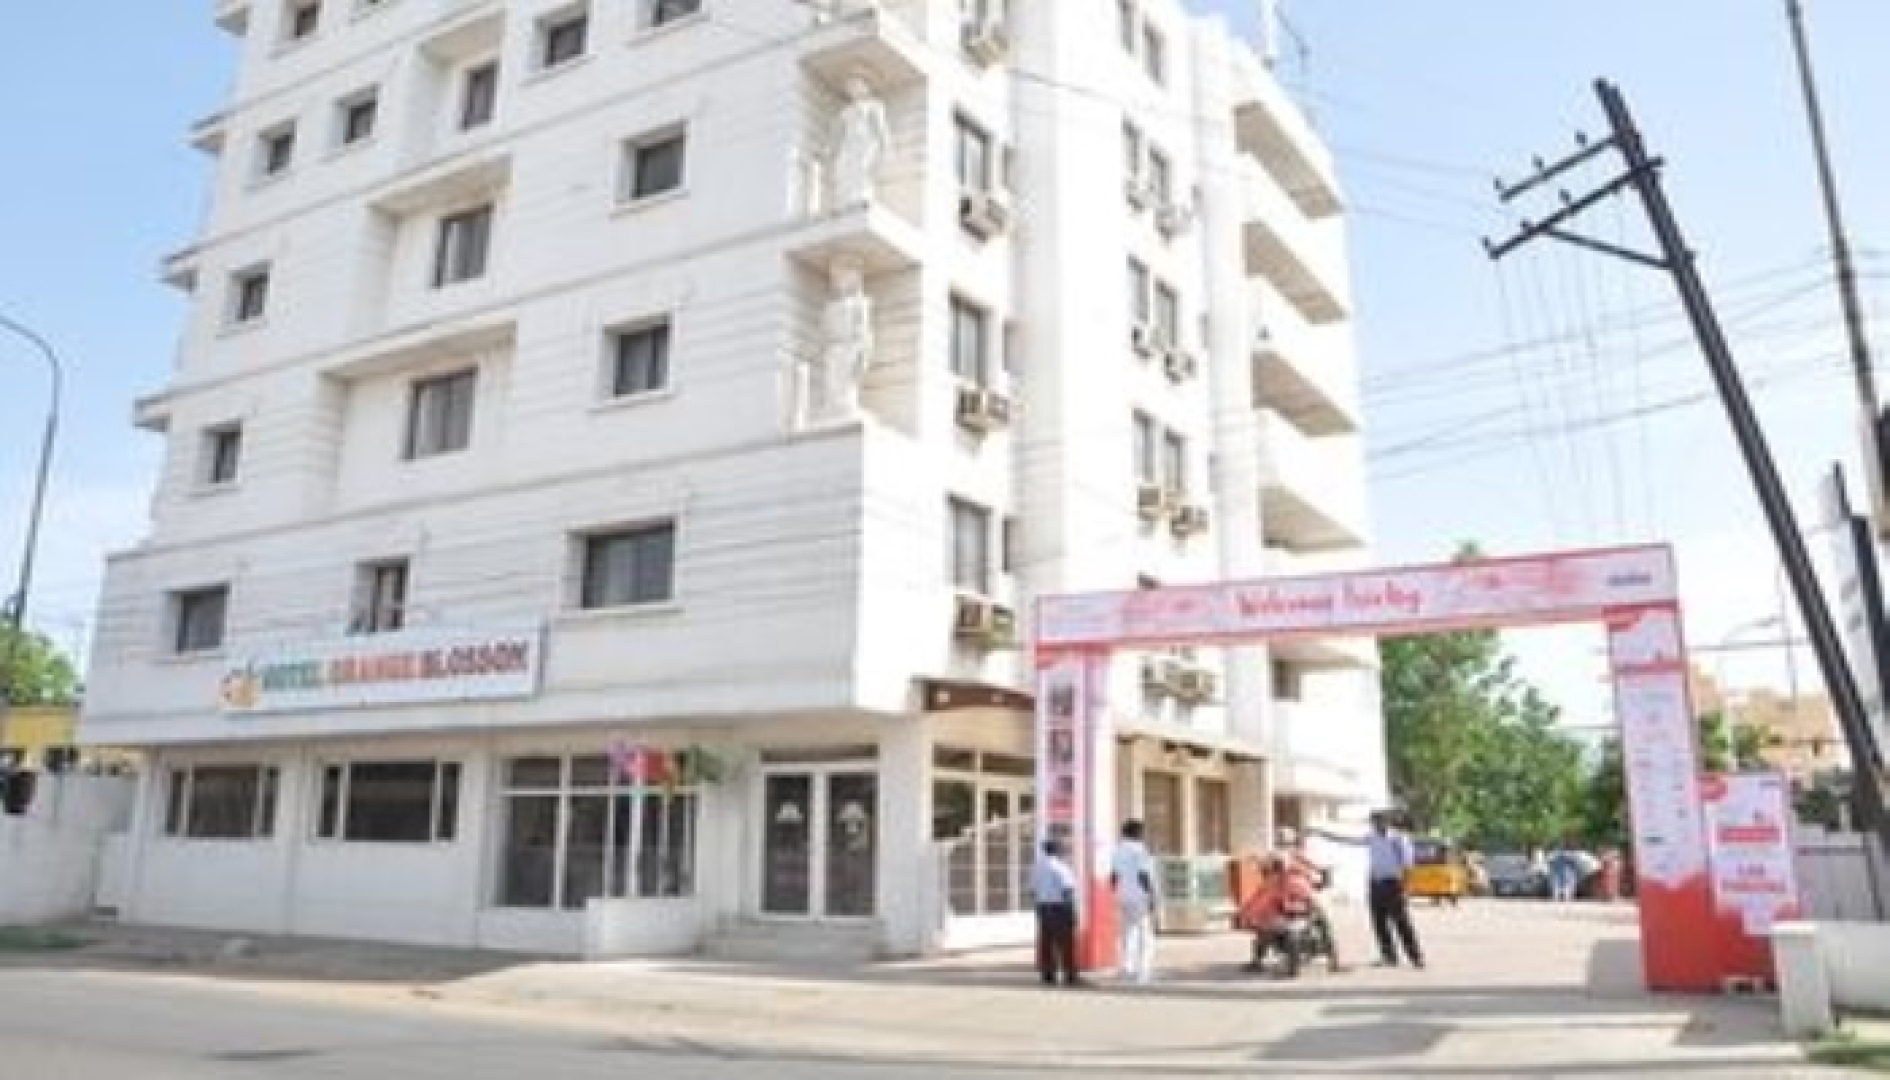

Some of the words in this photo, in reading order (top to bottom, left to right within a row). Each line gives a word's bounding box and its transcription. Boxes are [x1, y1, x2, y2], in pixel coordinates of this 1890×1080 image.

[261, 660, 322, 691] HOTEL
[325, 651, 421, 686] ORANGE
[422, 640, 529, 678] BLOSSOM
